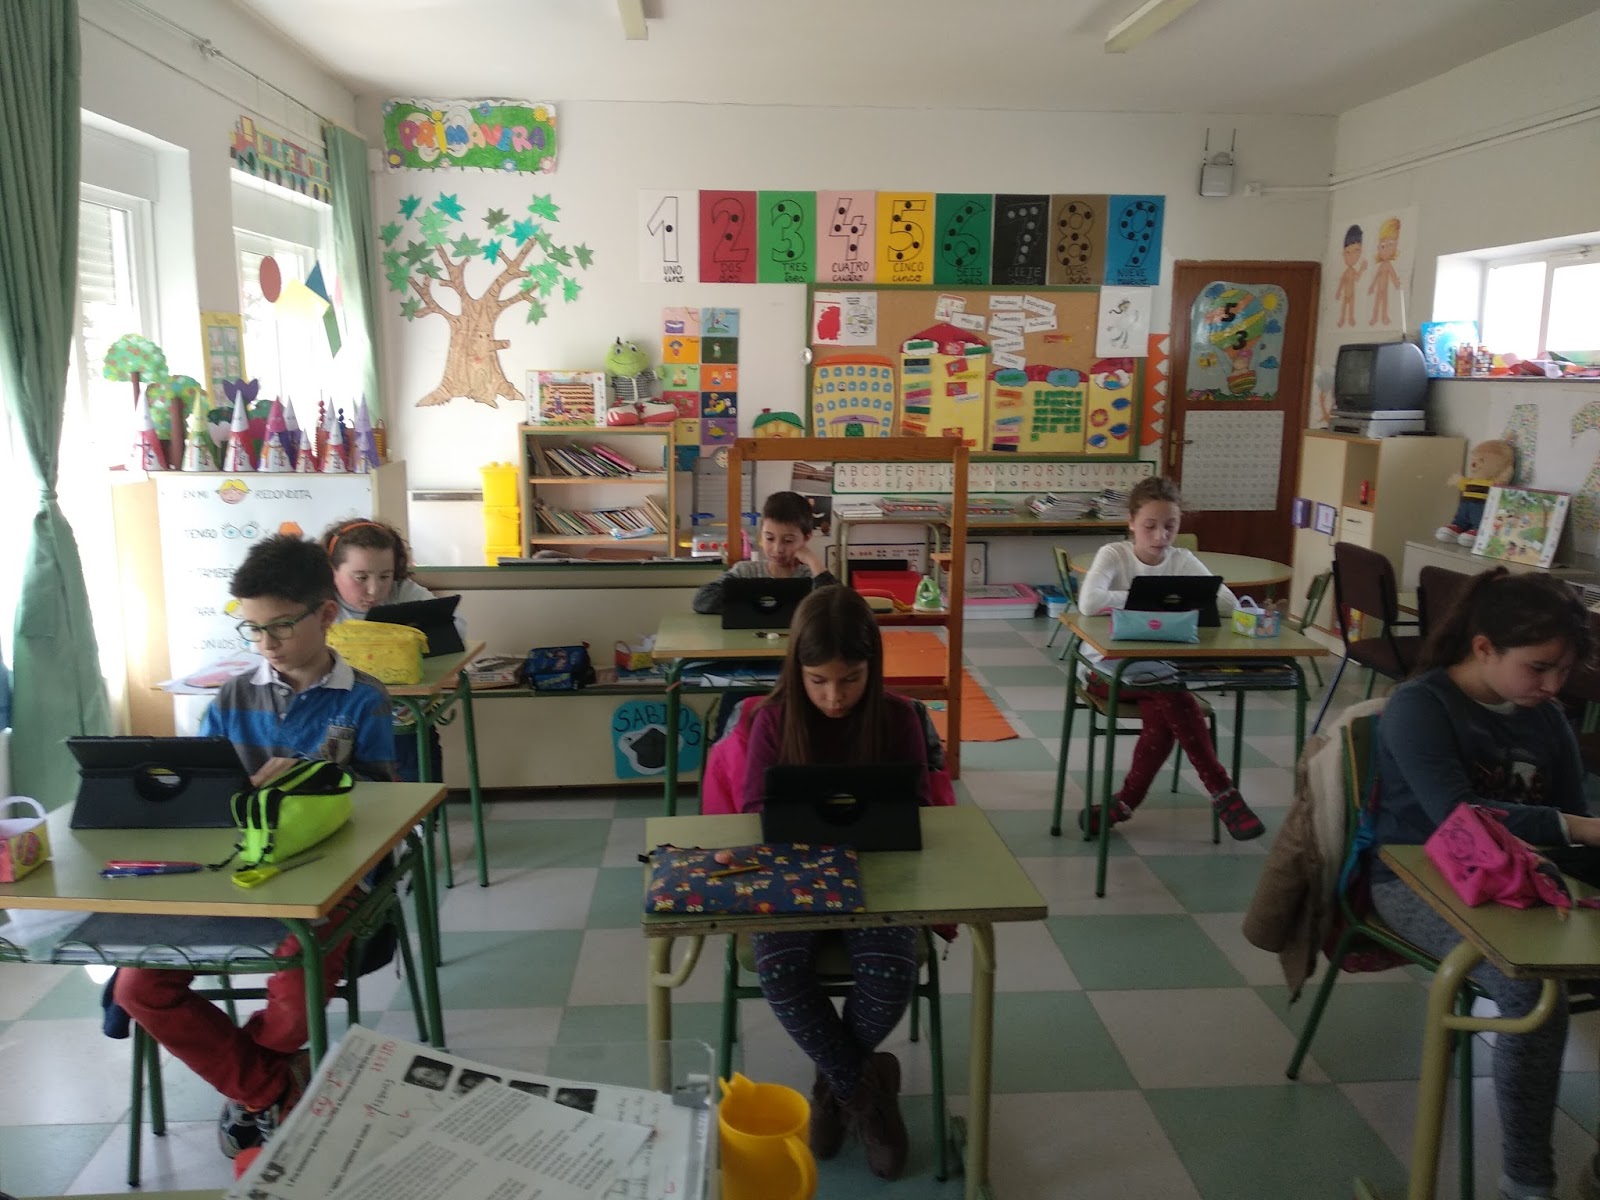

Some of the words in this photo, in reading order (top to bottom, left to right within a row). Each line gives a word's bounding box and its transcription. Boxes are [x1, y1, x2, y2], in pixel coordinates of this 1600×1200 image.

[398, 113, 546, 154] PRIMAVERA
[647, 196, 678, 262] 1
[712, 198, 749, 262] 2
[771, 199, 805, 262] 3
[829, 198, 867, 260] 4
[888, 200, 926, 262] 5
[941, 200, 986, 267] 6
[1005, 201, 1046, 266] 7
[1056, 201, 1095, 266] 8
[1119, 200, 1158, 267] 9
[663, 265, 683, 275] UNO
[720, 263, 742, 273] DOS
[782, 263, 808, 272] TRES
[832, 262, 869, 272] CUATRO
[893, 264, 925, 272] CINCO
[956, 266, 983, 277] SEIS
[1007, 267, 1041, 277] SIETE
[1221, 302, 1238, 323] 5
[1232, 330, 1248, 351] 3
[255, 489, 313, 500] REDONDITA
[184, 529, 218, 539] TENGO
